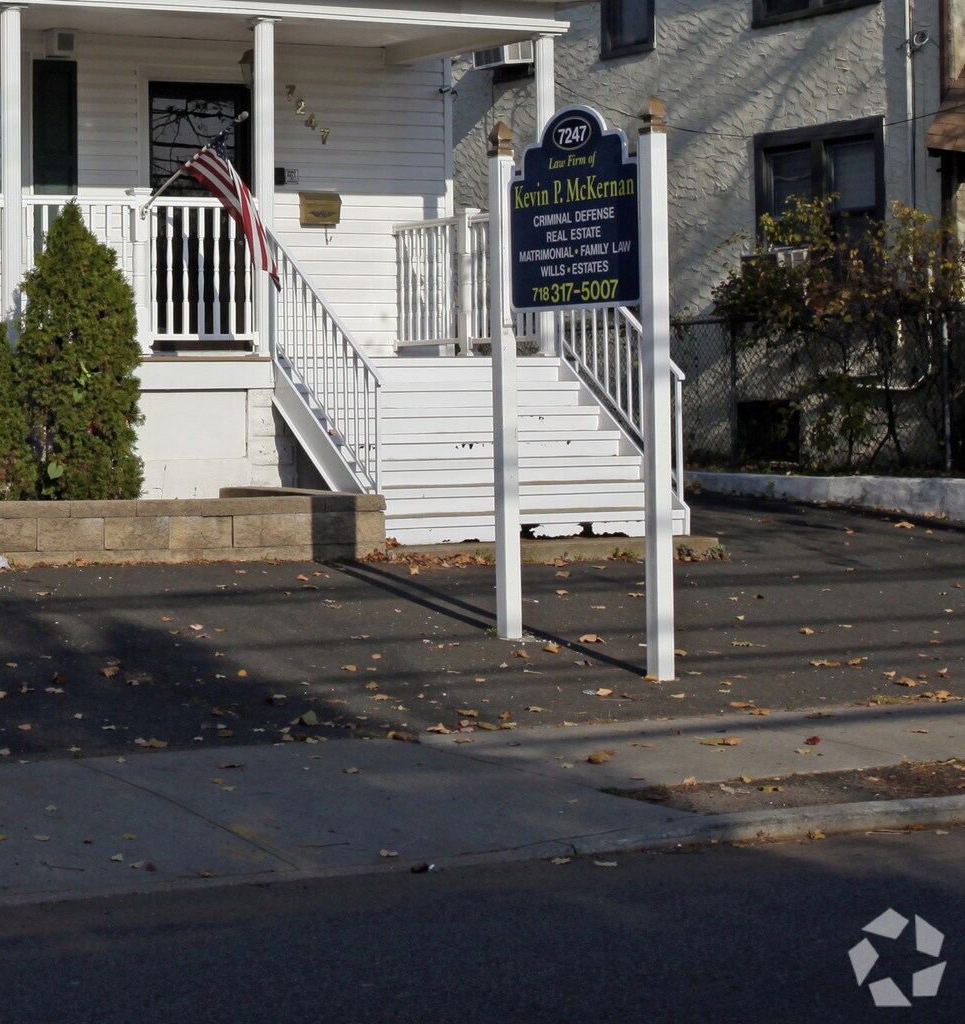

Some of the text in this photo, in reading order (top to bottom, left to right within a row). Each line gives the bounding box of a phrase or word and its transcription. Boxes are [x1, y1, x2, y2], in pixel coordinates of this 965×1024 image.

[557, 126, 587, 144] 7247
[548, 151, 597, 170] Law Firm of
[515, 175, 634, 209] Kevin P. McKernan
[533, 207, 615, 227] CRIMINAL DEFENSE
[546, 226, 601, 242] REAL ESTATE
[519, 240, 631, 262] MATRIMONIAL FAMILY LAW
[541, 260, 609, 277] WILLS ESTATES
[532, 279, 618, 302] 718 317-5007
